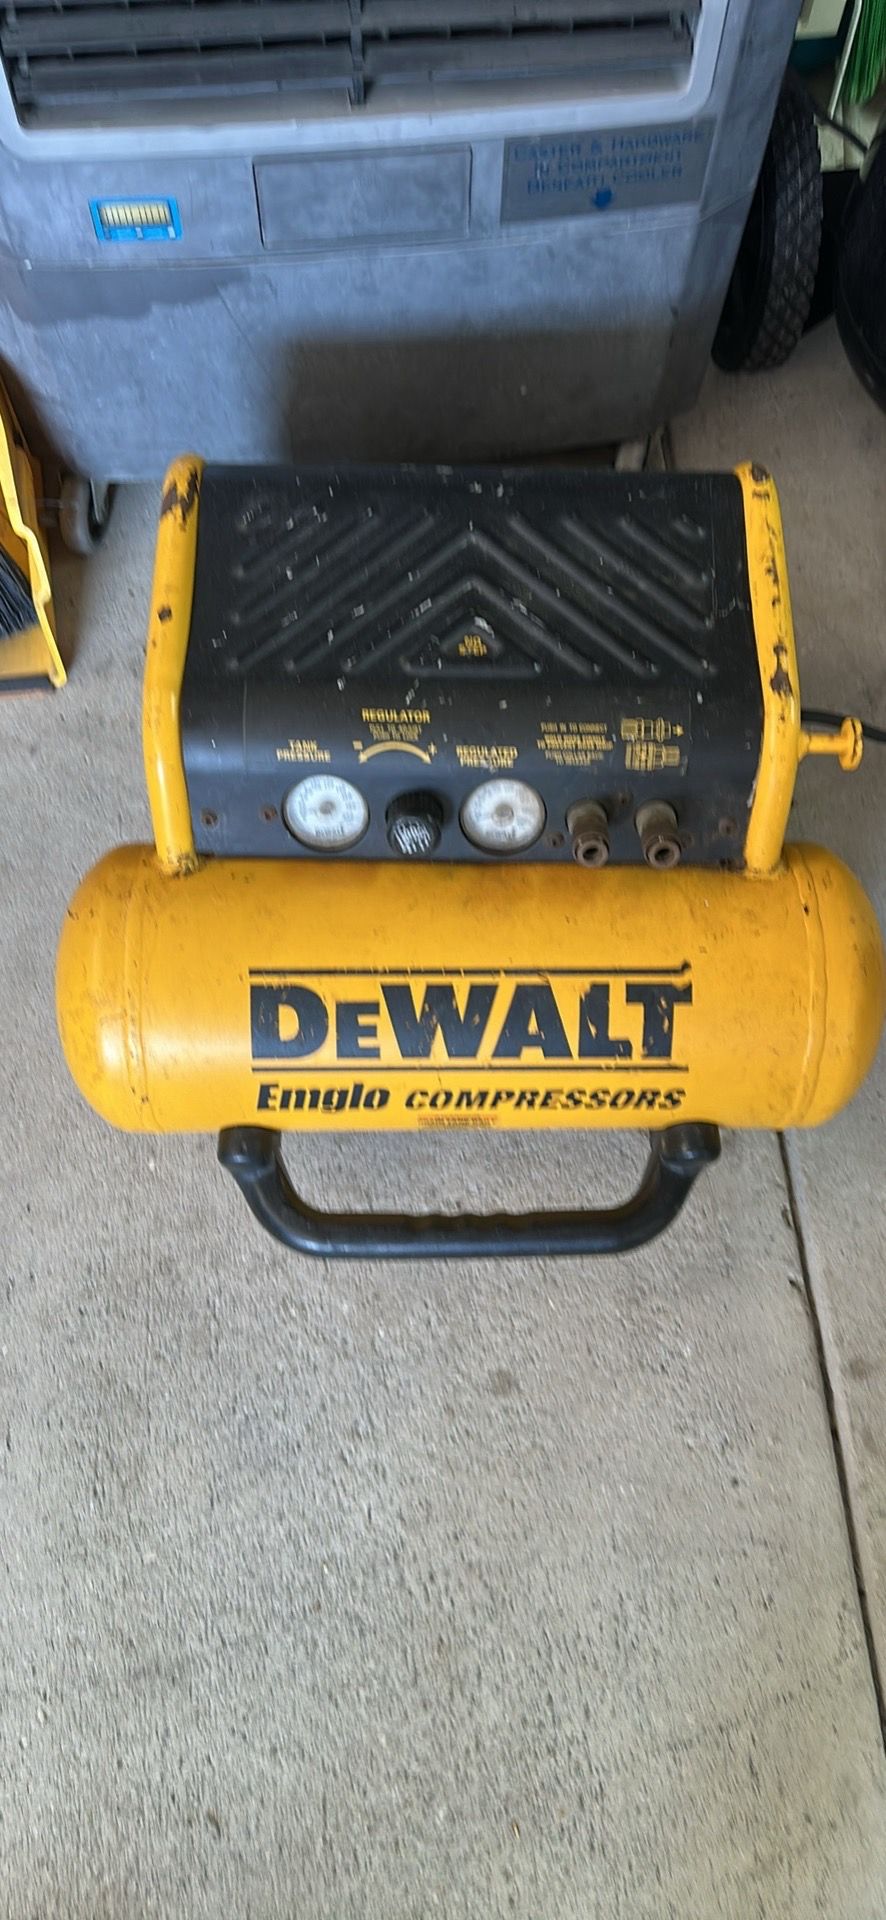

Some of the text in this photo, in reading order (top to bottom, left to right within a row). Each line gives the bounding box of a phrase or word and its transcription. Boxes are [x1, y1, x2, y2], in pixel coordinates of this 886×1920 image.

[361, 708, 431, 723] REGULATOR
[287, 739, 317, 751] TANK
[455, 745, 518, 759] REGULATED
[276, 748, 331, 762] PRESSURE
[257, 1083, 686, 1113] Emglo COMPRESSORS
